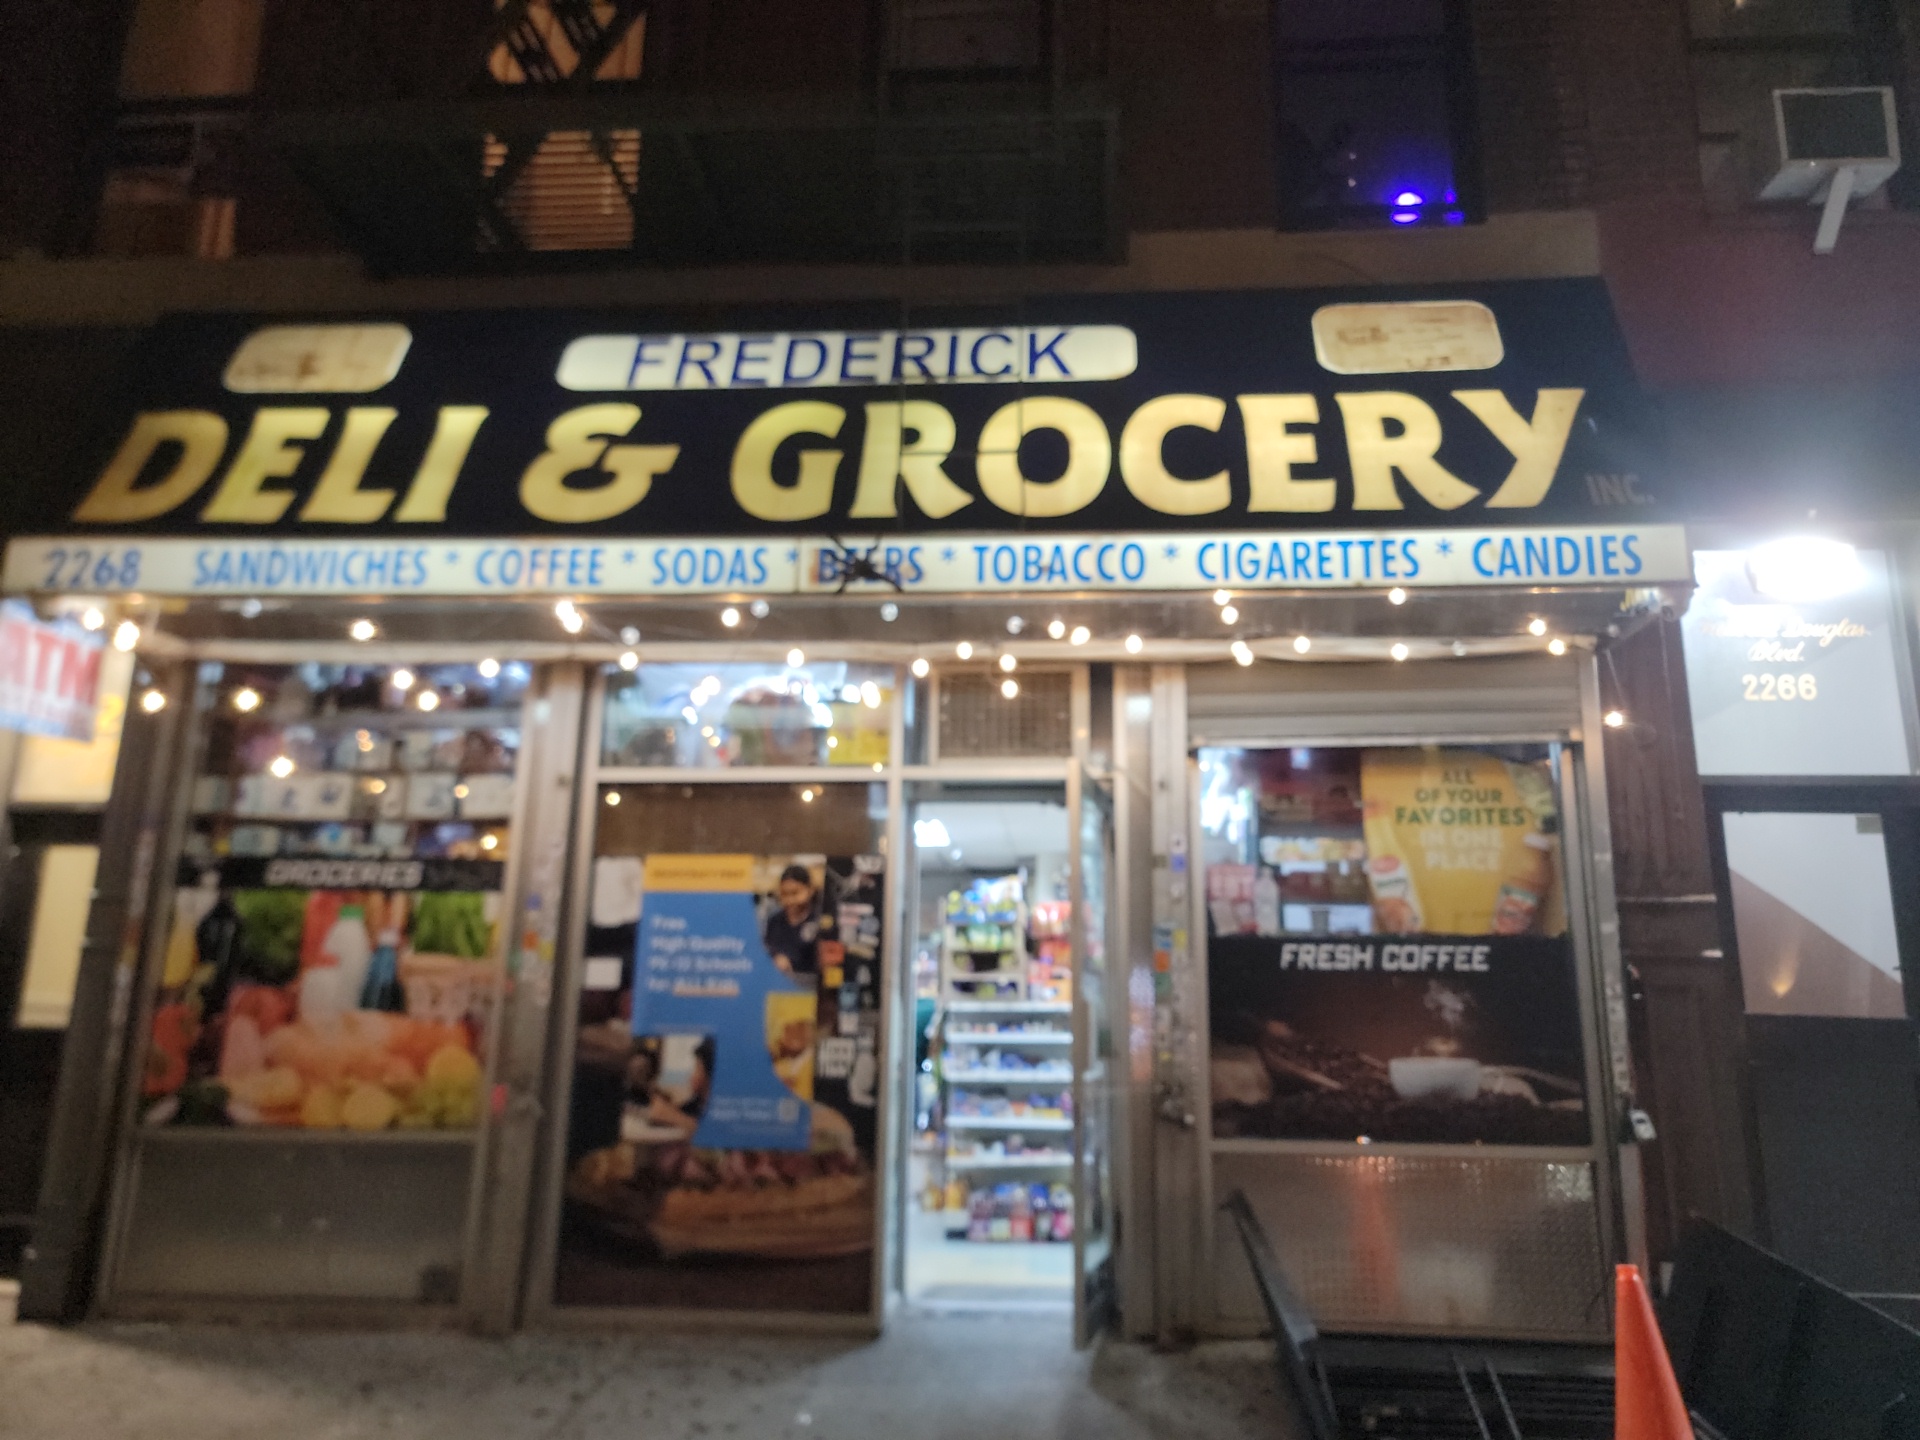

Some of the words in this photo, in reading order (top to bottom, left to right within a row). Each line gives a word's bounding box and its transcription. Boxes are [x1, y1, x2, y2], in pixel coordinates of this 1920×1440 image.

[627, 331, 1072, 388] FREDERICK
[73, 405, 490, 524] DELI
[518, 402, 680, 523] &
[730, 387, 1585, 522] GROCERY
[43, 548, 141, 588] 2268
[194, 548, 428, 587] SANDWICHES
[474, 547, 605, 587] COFFEE
[652, 546, 768, 586] SODAS
[972, 541, 1146, 584] TOBACCO
[1196, 537, 1420, 582] CIGARETTES
[1472, 533, 1643, 579] CANDIES
[1742, 673, 1817, 701] 2266
[1441, 767, 1475, 785] ALL
[1415, 788, 1439, 803] OF
[1446, 787, 1503, 803] YOUR
[1395, 806, 1525, 826] FAVORITES
[1280, 943, 1373, 971] FRESH
[1381, 945, 1490, 972] COFFEE
